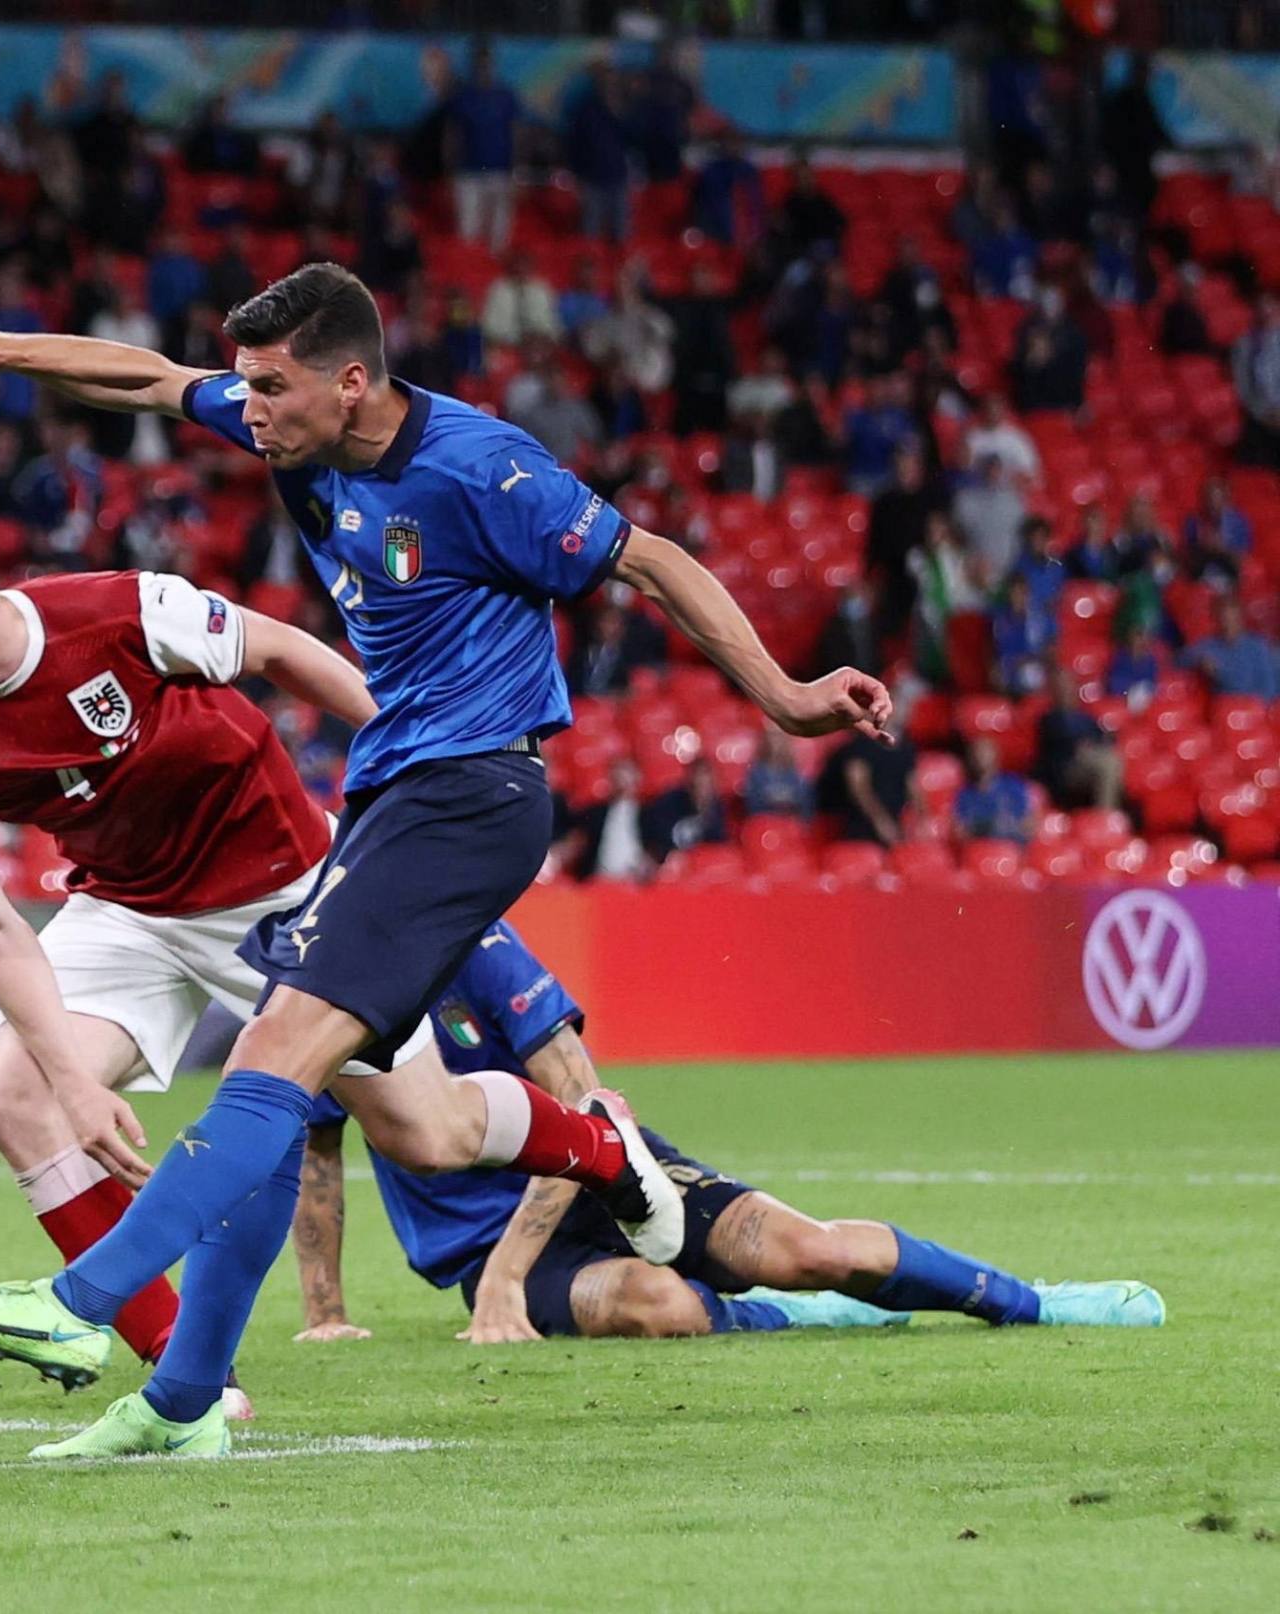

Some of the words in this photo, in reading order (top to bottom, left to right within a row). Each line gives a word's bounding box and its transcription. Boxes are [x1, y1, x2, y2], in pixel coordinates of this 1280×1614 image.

[386, 529, 418, 541] ITALIA
[573, 493, 604, 537] RESPECT
[1086, 891, 1204, 1042] VW
